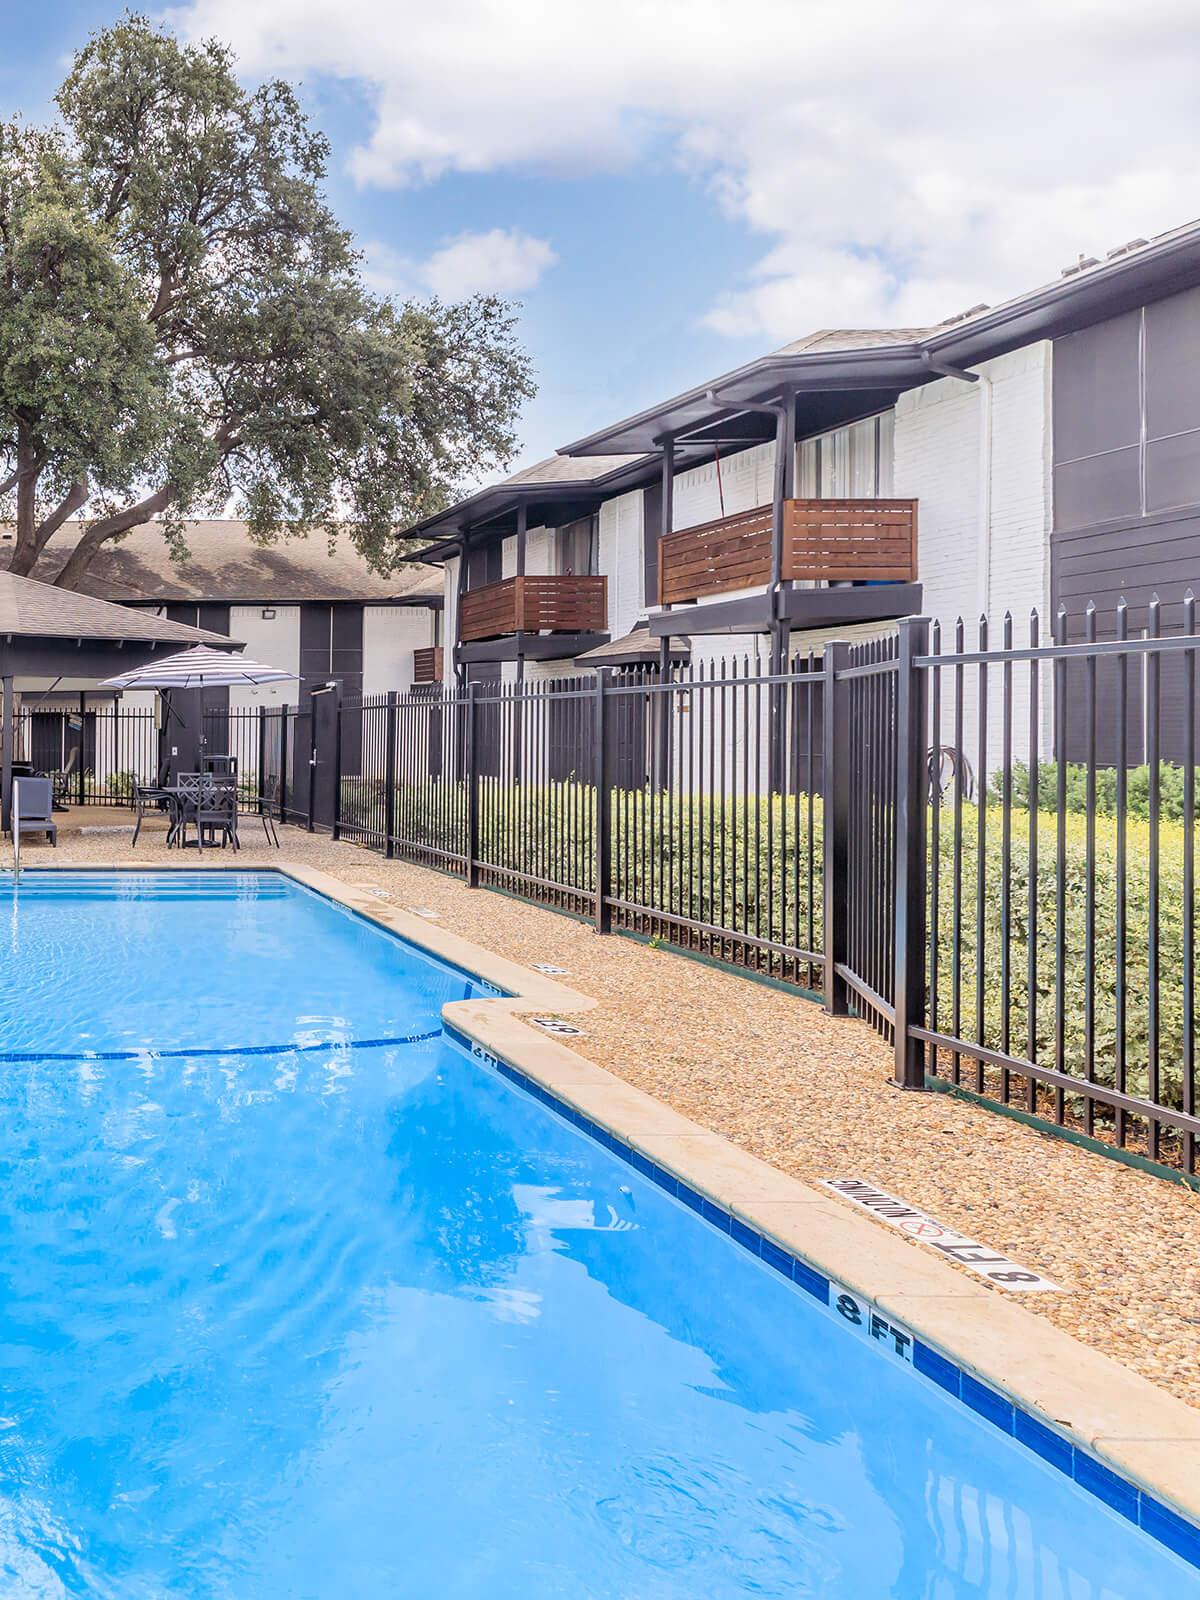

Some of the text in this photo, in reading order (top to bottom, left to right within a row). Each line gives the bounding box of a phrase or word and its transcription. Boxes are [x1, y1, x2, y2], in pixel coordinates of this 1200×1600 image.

[473, 1047, 497, 1067] 6 FT
[826, 1180, 922, 1218] NO DIVING
[931, 1241, 1041, 1283] 8 FT
[835, 1294, 863, 1326] 8
